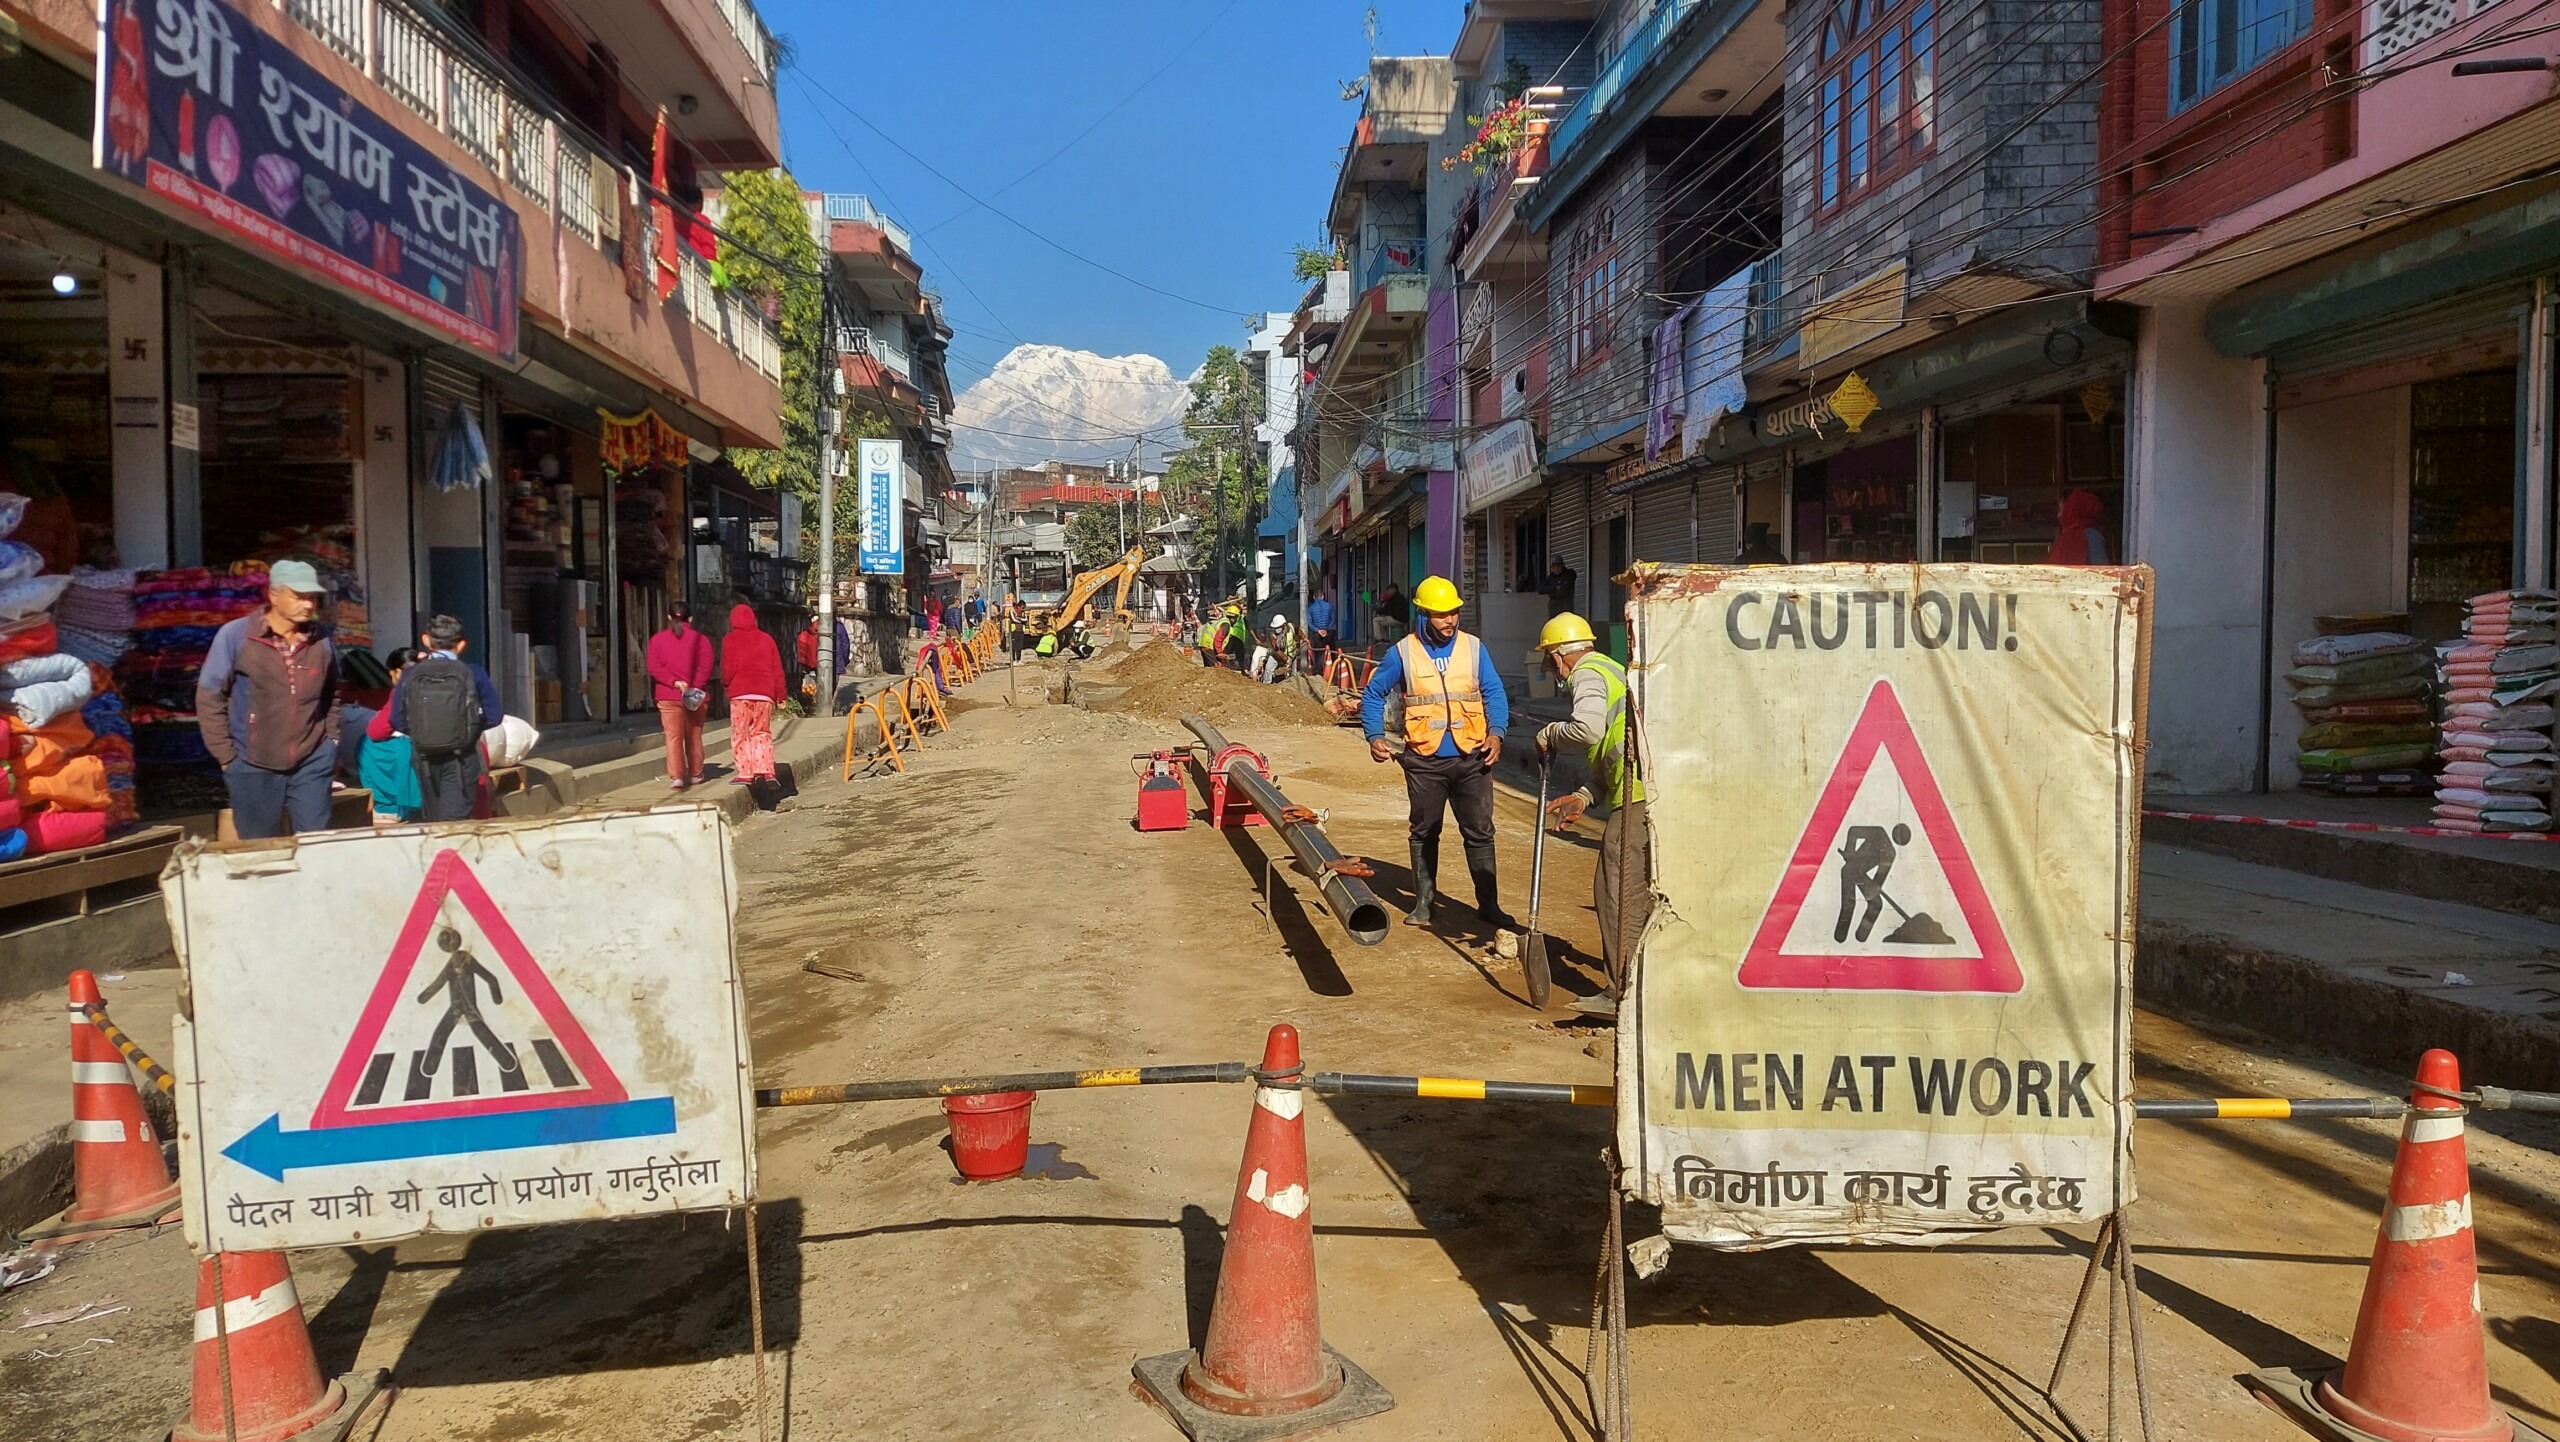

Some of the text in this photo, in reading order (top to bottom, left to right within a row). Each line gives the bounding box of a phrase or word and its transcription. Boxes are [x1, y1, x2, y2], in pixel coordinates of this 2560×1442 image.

[154, 0, 241, 108] श्री
[259, 60, 395, 204] श्याम
[406, 162, 500, 268] स्टोर्स
[1085, 574, 1108, 592] CASE
[1726, 589, 2018, 652] CAUTION!
[1674, 1052, 2096, 1118] MEN AT WORK
[227, 1155, 721, 1228] पैदल यात्री यो बाटो प्रयोग गर्नुहोला
[1672, 1154, 2087, 1221] निर्माण कार्य हुदैछ
